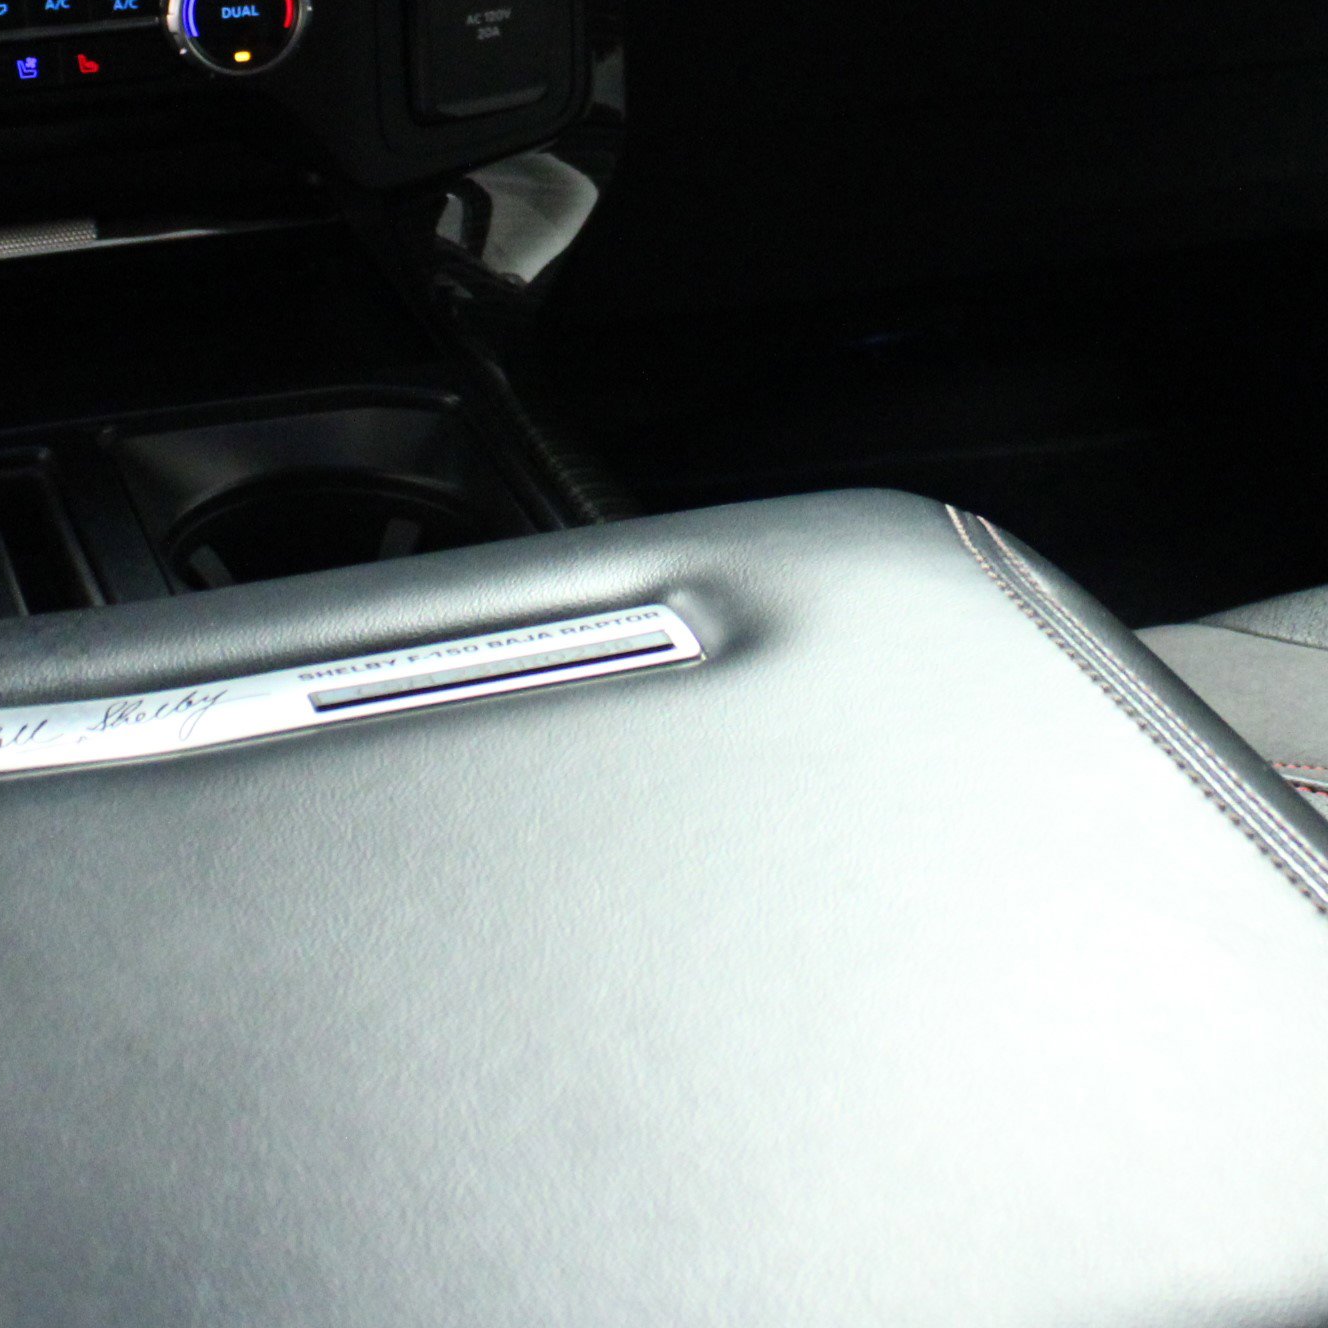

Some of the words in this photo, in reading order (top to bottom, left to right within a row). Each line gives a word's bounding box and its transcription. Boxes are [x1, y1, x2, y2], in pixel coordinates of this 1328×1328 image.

[221, 4, 260, 19] DUAL
[297, 658, 396, 682] SHELBY
[407, 644, 479, 663] F-150
[487, 631, 552, 649] BAJA
[559, 611, 661, 635] RAPTOR
